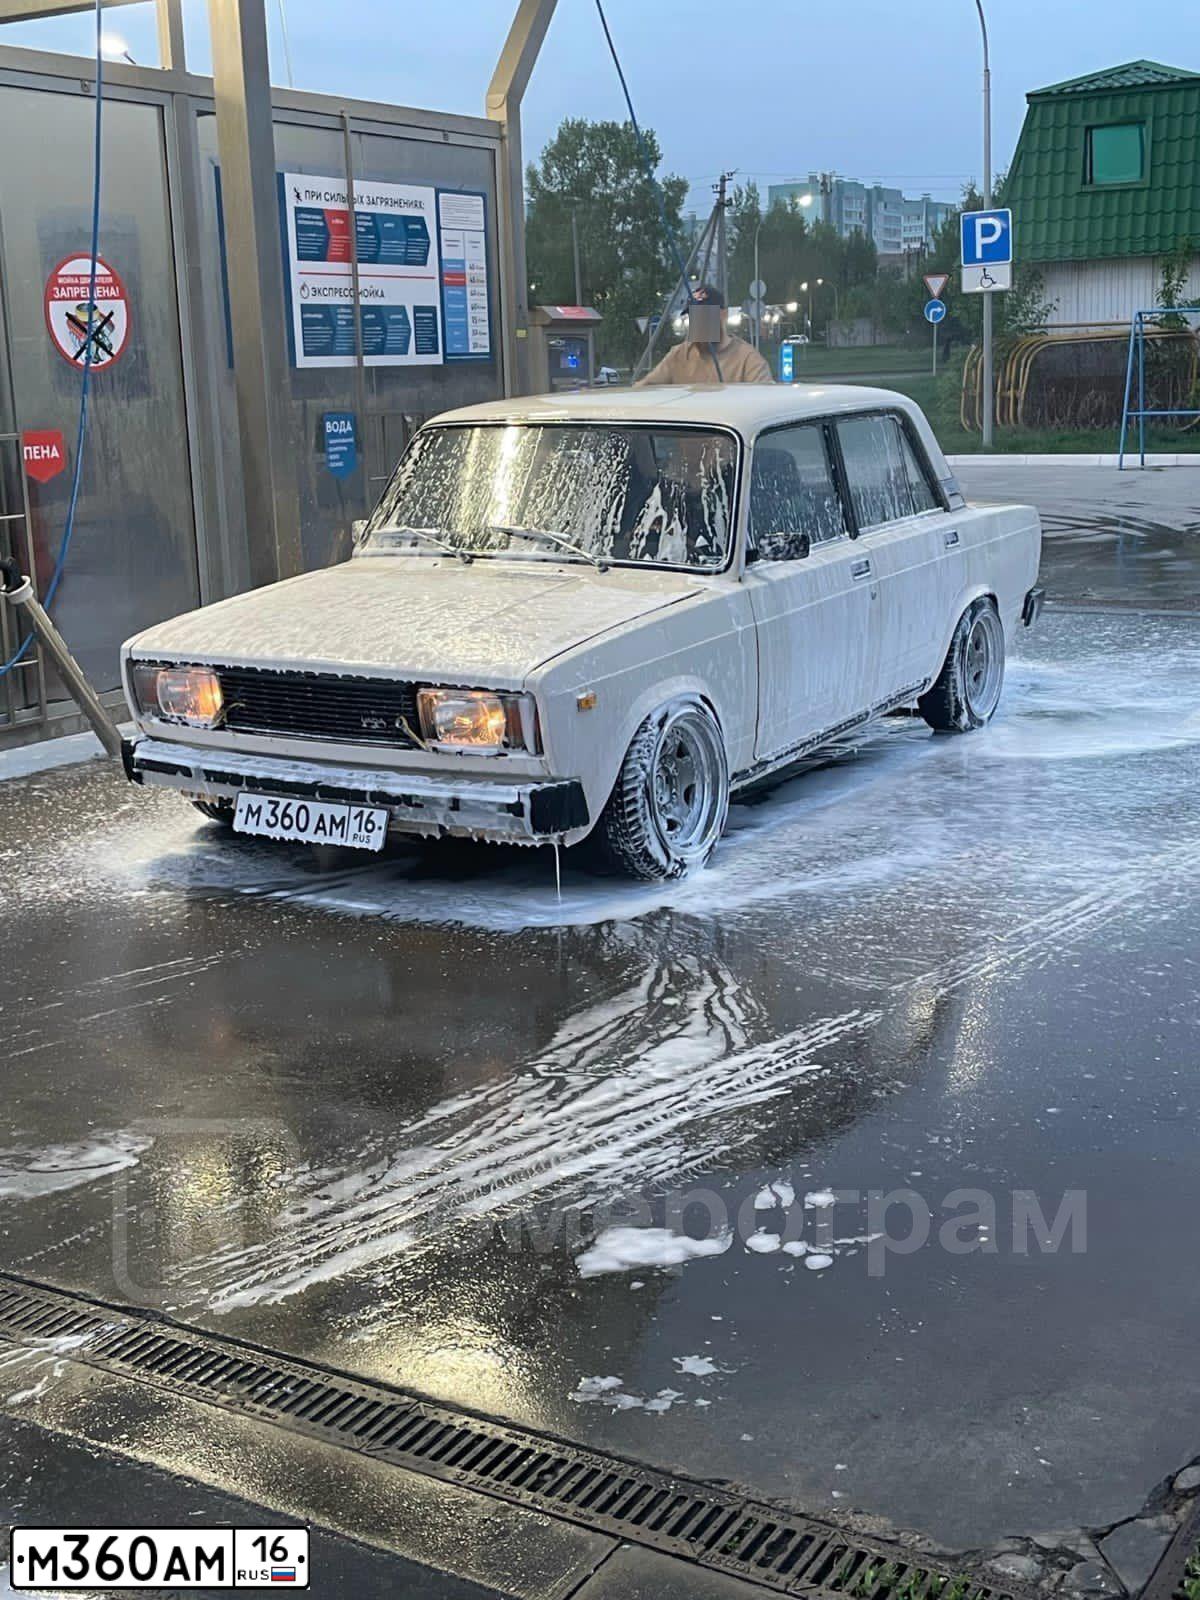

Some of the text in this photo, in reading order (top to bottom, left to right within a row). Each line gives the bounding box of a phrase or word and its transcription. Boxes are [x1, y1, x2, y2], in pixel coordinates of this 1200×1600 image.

[304, 190, 322, 200] ПРИ
[324, 192, 364, 206] СИЛЬЫХ
[975, 217, 1002, 259] P
[80, 276, 113, 284] ДВИАТЕЛЯ
[325, 421, 352, 433] ВОДА
[23, 445, 60, 460] ПЕНА
[352, 833, 372, 844] RUS
